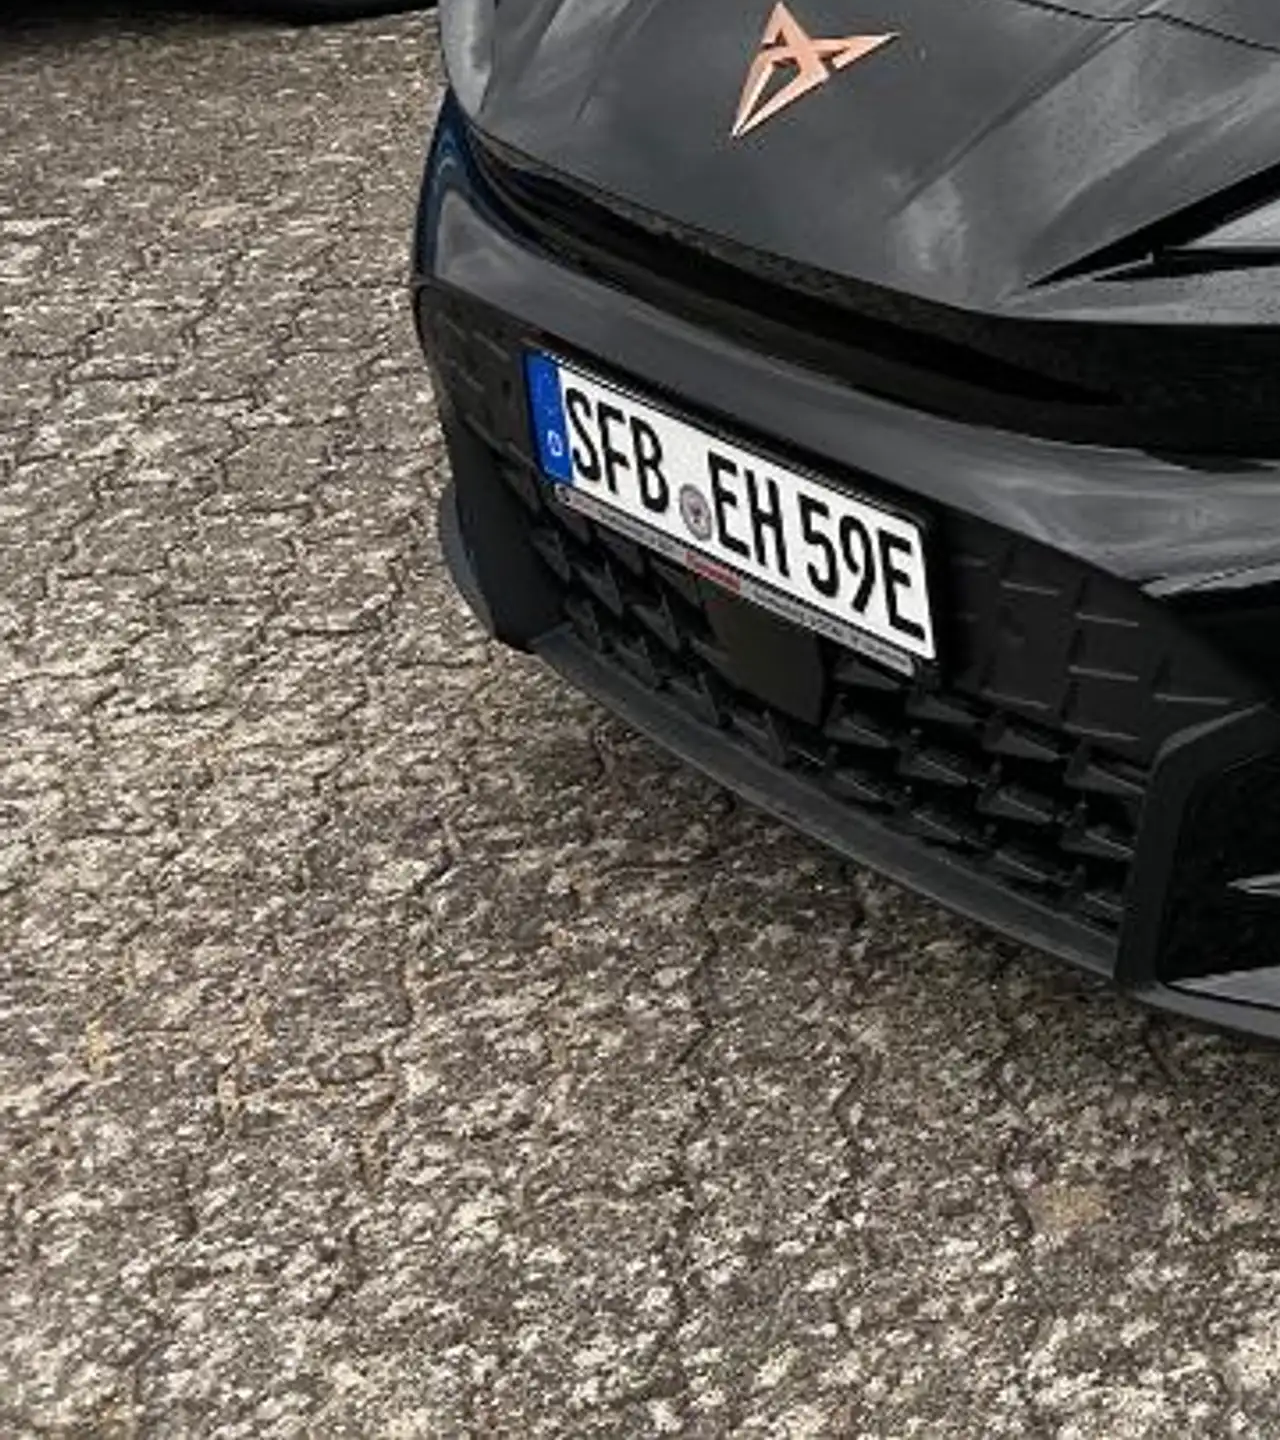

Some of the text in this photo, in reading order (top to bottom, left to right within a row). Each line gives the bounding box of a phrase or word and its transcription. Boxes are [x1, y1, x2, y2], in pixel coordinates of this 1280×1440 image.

[565, 387, 670, 514] SFB
[707, 448, 790, 579] EH
[797, 491, 926, 642] 59E
